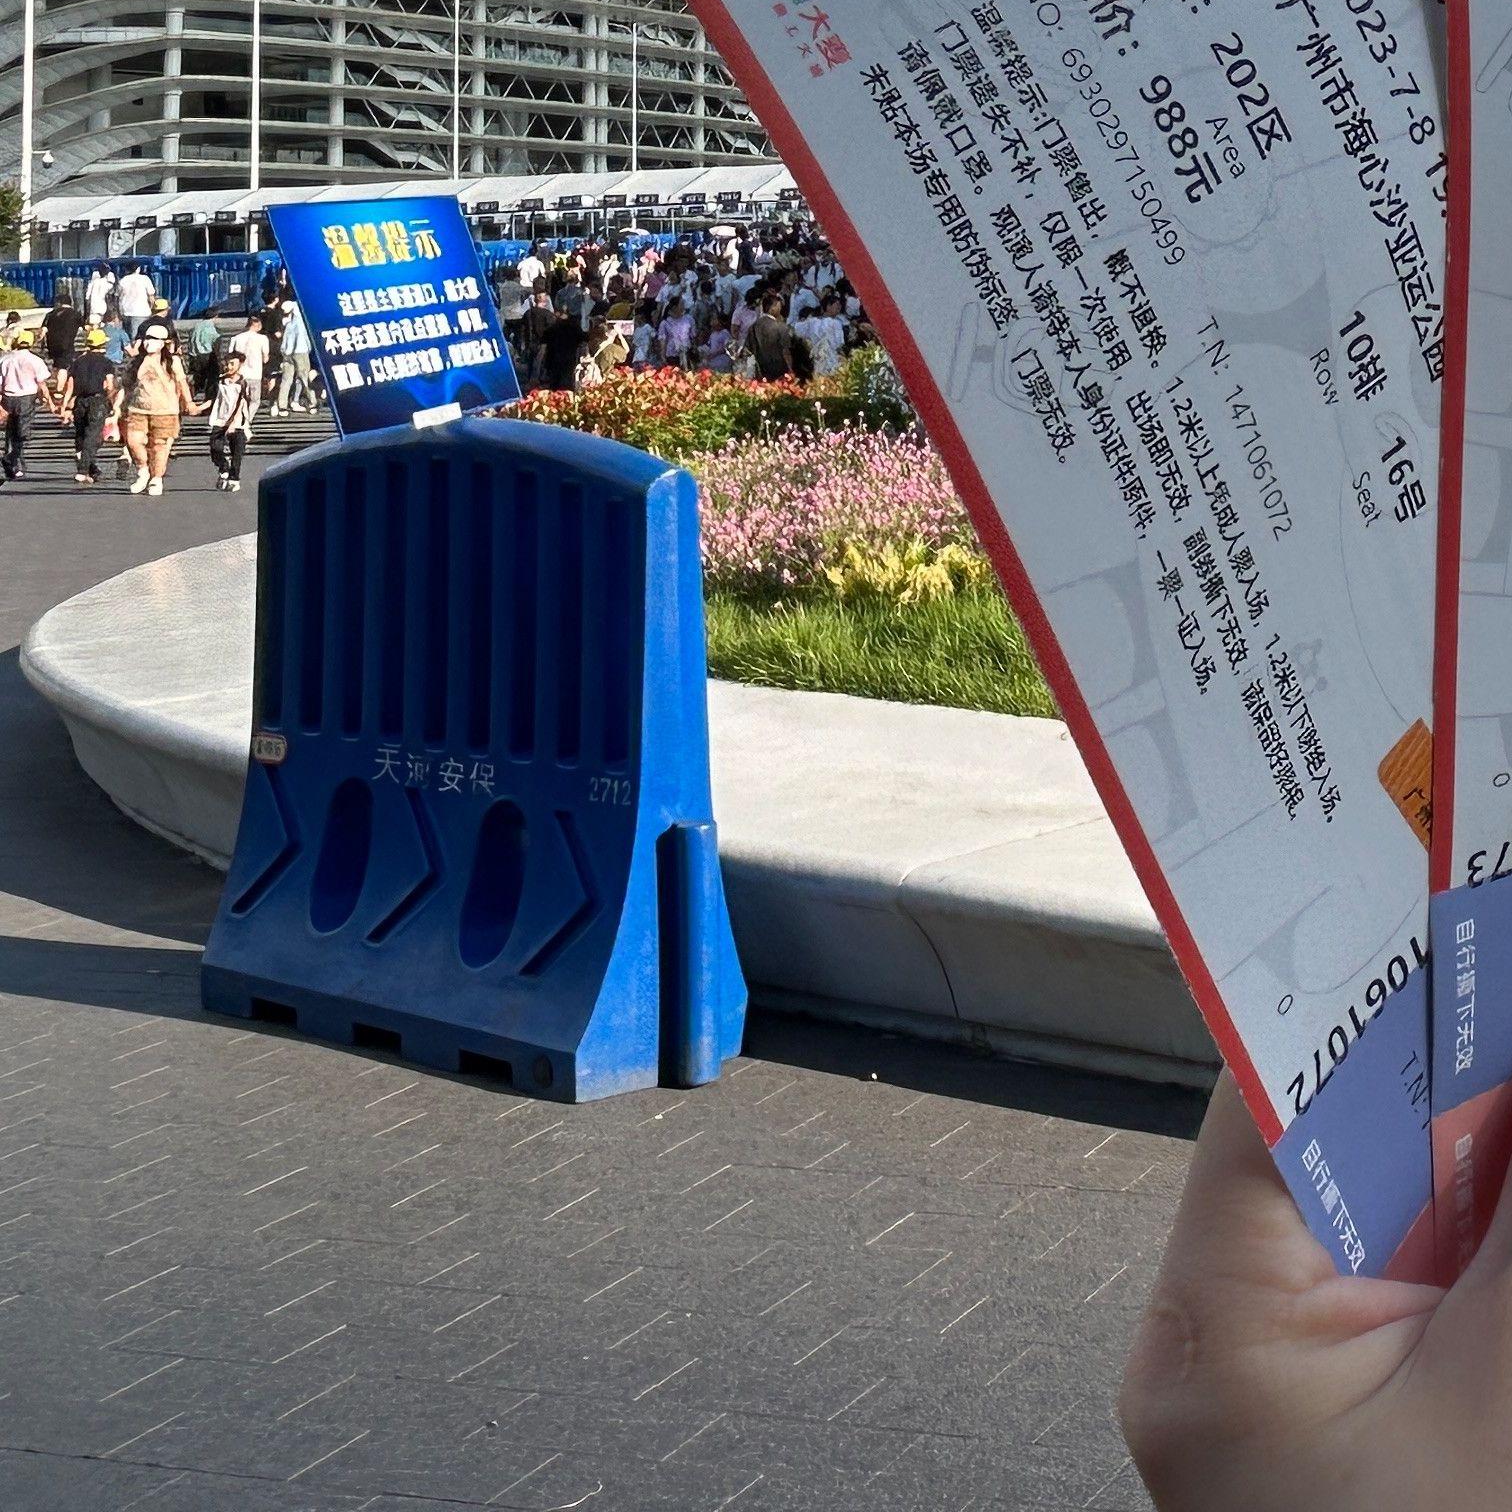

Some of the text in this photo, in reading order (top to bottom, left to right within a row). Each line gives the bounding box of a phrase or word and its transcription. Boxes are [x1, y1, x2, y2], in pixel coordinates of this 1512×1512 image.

[1057, 45, 1189, 269] 6930297150499
[1193, 315, 1234, 378] T.N:
[1219, 382, 1296, 542] 1471061072
[1135, 73, 1225, 206] 988元
[1203, 111, 1250, 180] Area
[1307, 347, 1344, 410] Row
[1344, 470, 1387, 532] Seat
[1206, 29, 1295, 161] 202区
[1333, 309, 1393, 406] 10排
[1370, 433, 1435, 530] 16号
